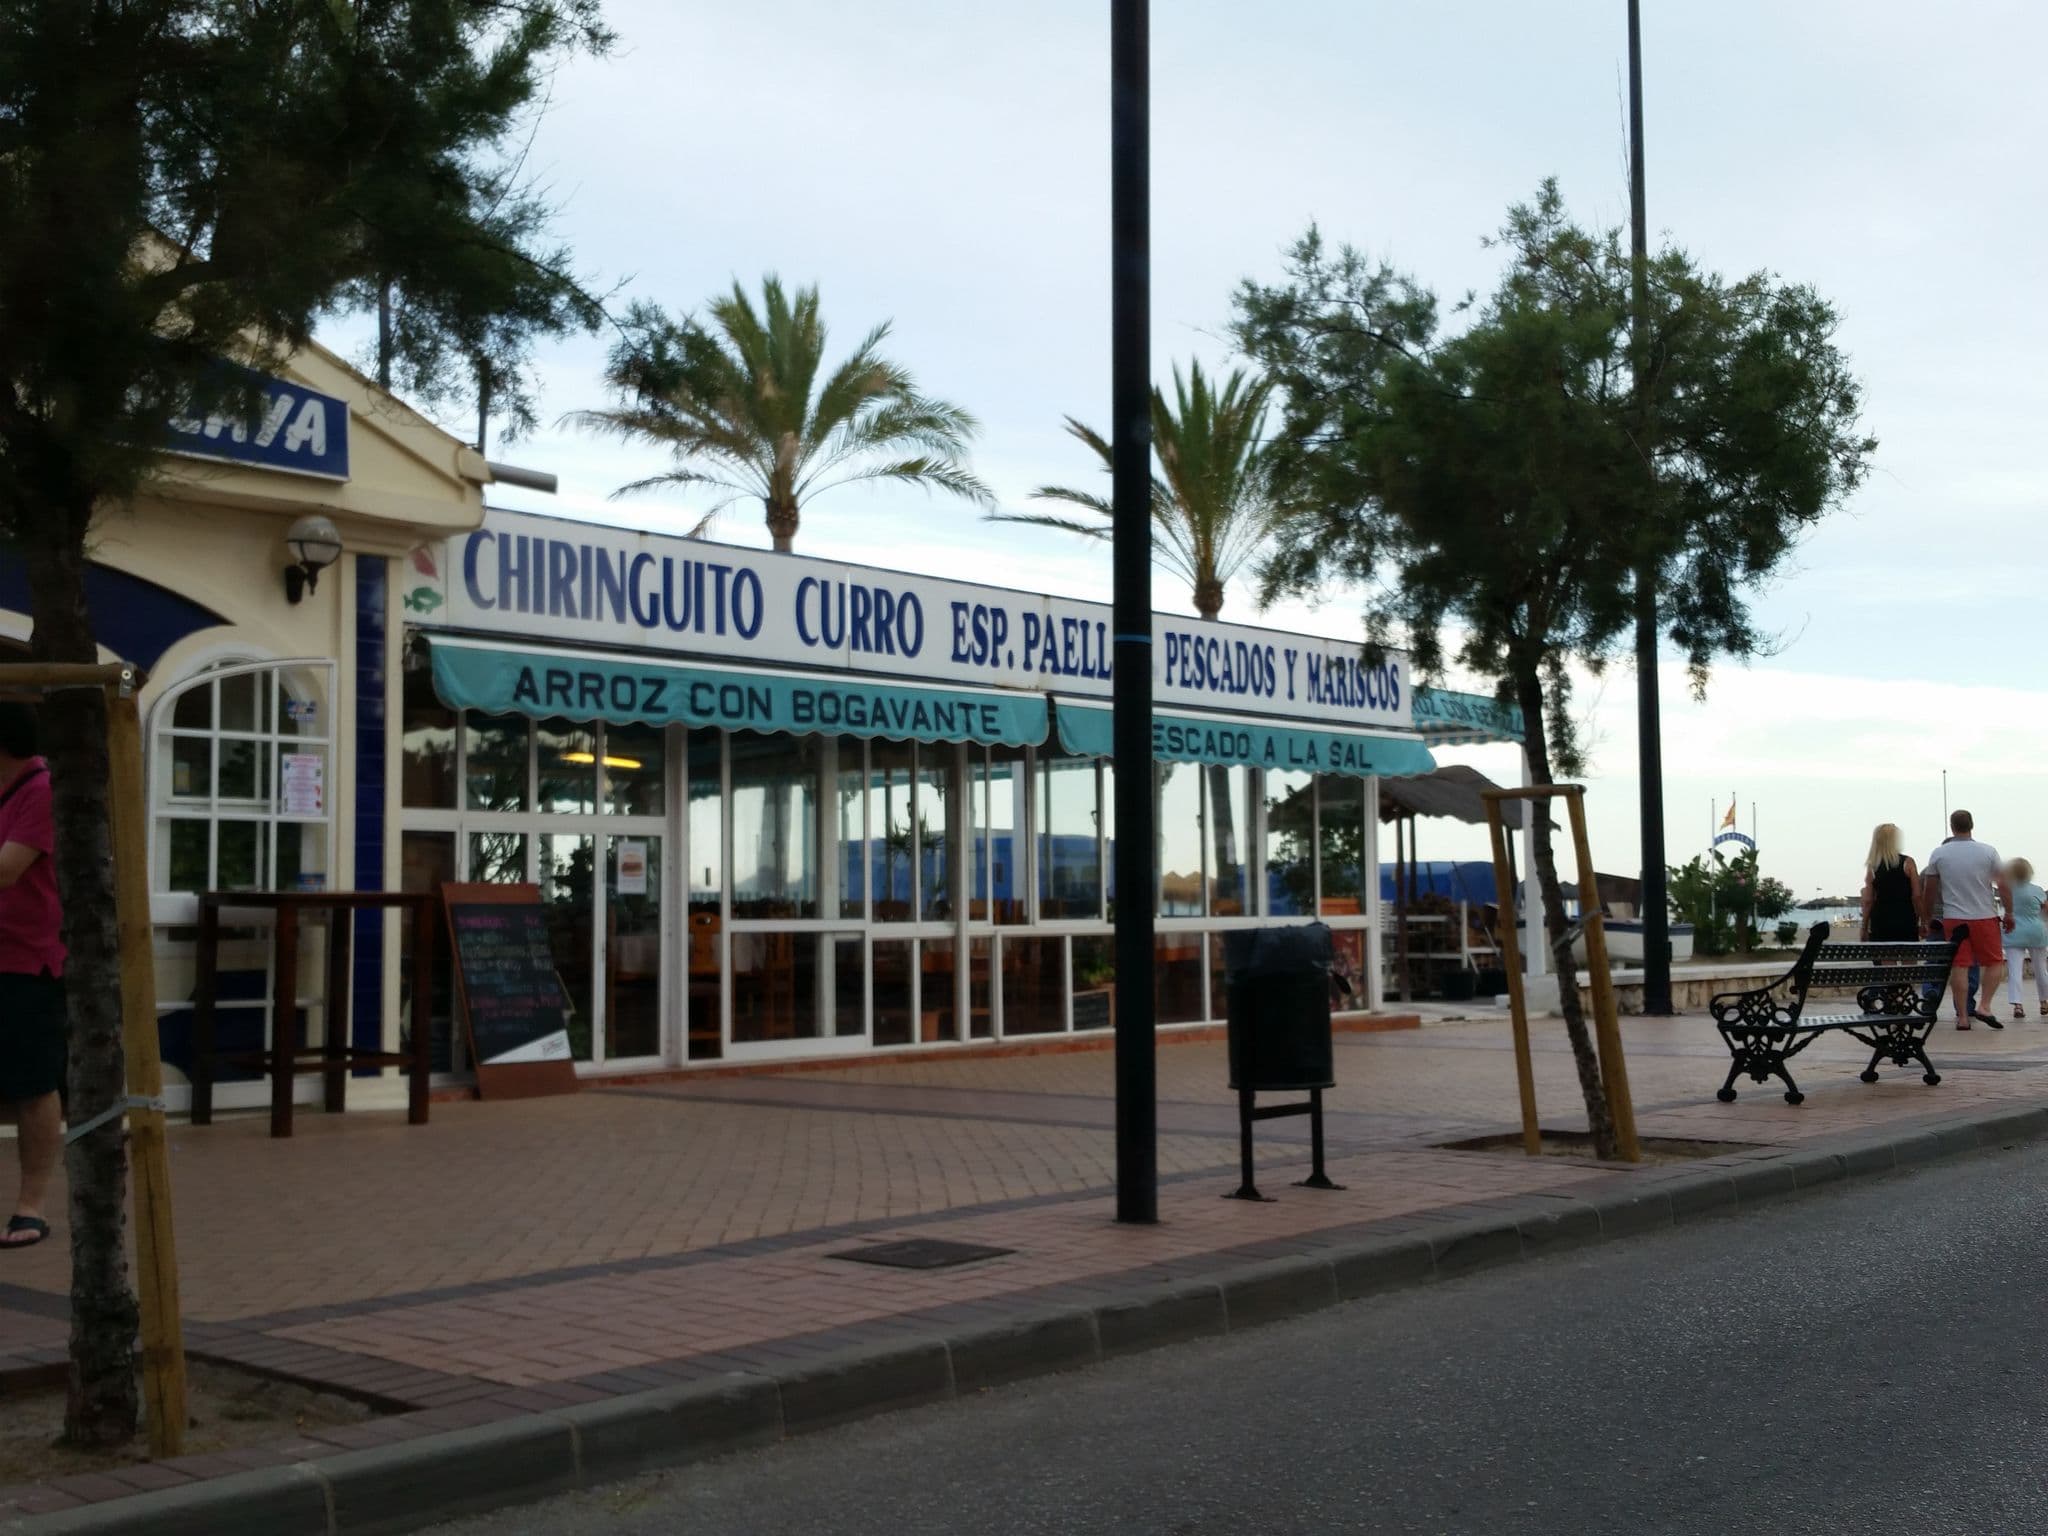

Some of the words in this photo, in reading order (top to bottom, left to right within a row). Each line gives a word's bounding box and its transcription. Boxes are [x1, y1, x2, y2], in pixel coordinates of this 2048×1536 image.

[463, 530, 764, 640] CHIRINGUITO
[795, 576, 924, 659] CURRO
[951, 602, 1014, 670] ESP.
[1023, 612, 1113, 681] PAELL
[1165, 631, 1277, 699] PESCADOS
[1283, 648, 1298, 701] Y
[1307, 653, 1400, 711] MARISCOS
[512, 665, 670, 714] ARROZ
[690, 682, 773, 721] CON
[792, 690, 1000, 736] BOGAVANTE
[1152, 723, 1250, 760] ESCADO
[1263, 735, 1277, 763] A
[1289, 738, 1319, 765] LA
[1329, 740, 1374, 769] SAL
